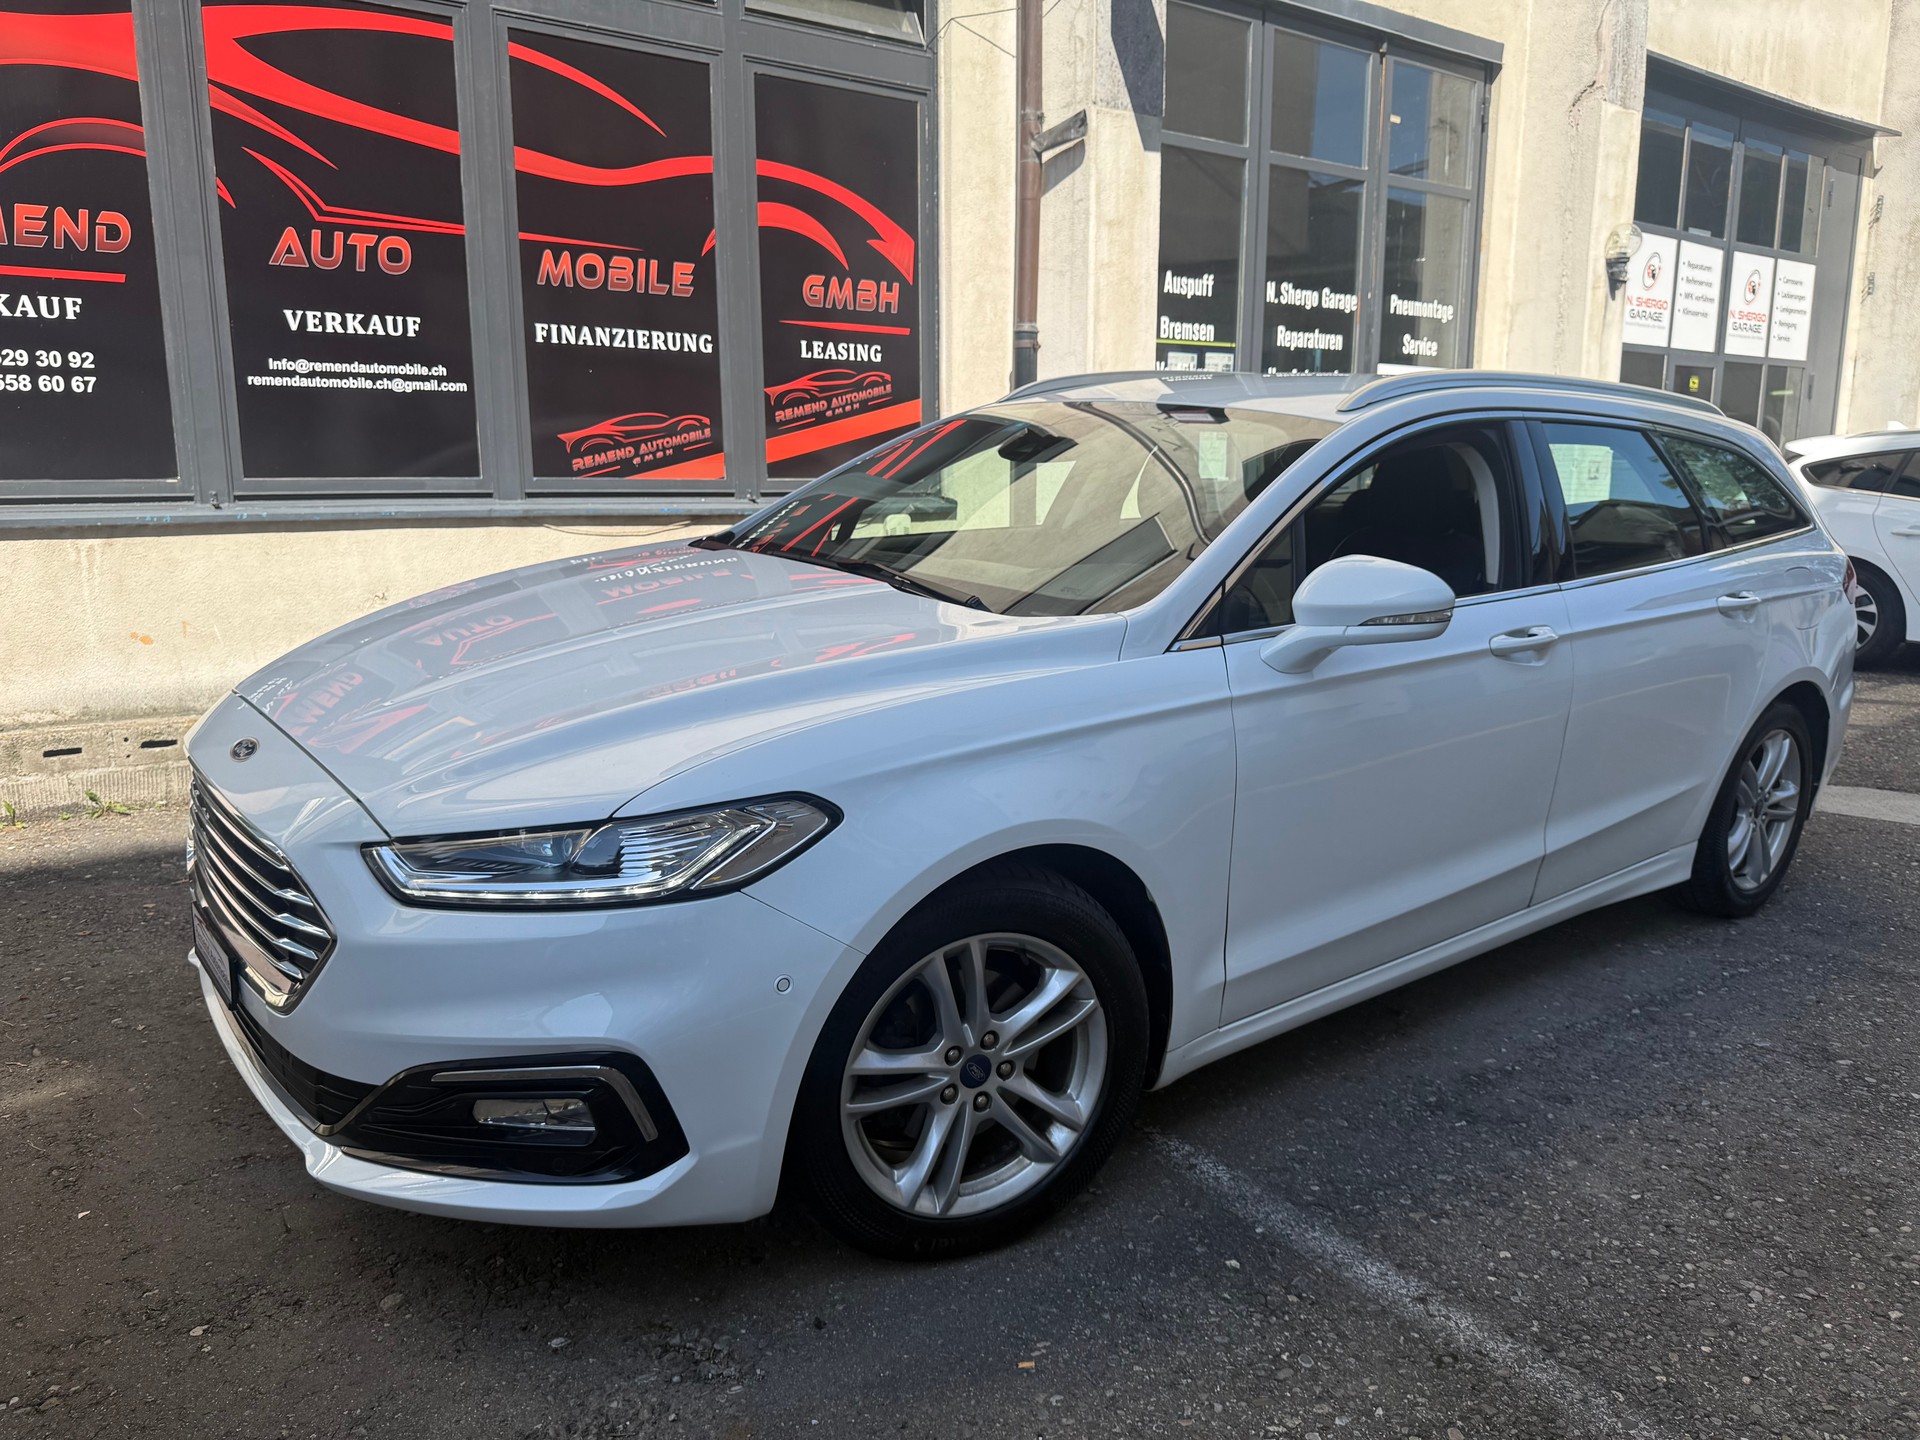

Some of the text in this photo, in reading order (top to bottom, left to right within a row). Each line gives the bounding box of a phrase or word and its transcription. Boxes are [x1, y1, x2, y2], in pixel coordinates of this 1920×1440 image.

[0, 203, 132, 253] END
[268, 226, 413, 275] AUTO
[536, 248, 697, 298] MOBILE
[1163, 270, 1215, 299] Auspuff
[802, 274, 900, 314] GMBH
[1266, 280, 1358, 314] N. Shergo Garage
[1636, 296, 1668, 311] SHERGO
[1390, 294, 1454, 323] Pneumontage
[1629, 308, 1663, 323] GARAGE
[1738, 310, 1767, 323] SHERGO
[282, 309, 421, 338] VERKAUF
[1159, 315, 1215, 343] Bremsen
[1732, 321, 1763, 334] GARAGE
[534, 322, 713, 354] FINANZIERUNG
[800, 339, 883, 363] LEASING
[1276, 324, 1344, 352] Reparaturen
[1402, 333, 1438, 357] Service
[0, 348, 96, 369] 29 30 92
[267, 357, 447, 377] Info@remendautomobile.ch
[37, 374, 65, 393] 60
[70, 375, 97, 393] 67
[247, 373, 468, 393] remendautomobile.ch@gmail.com
[775, 384, 892, 423] REMEND AUTOMOBILE
[572, 427, 713, 471] REMEND AUTOMOBILE
